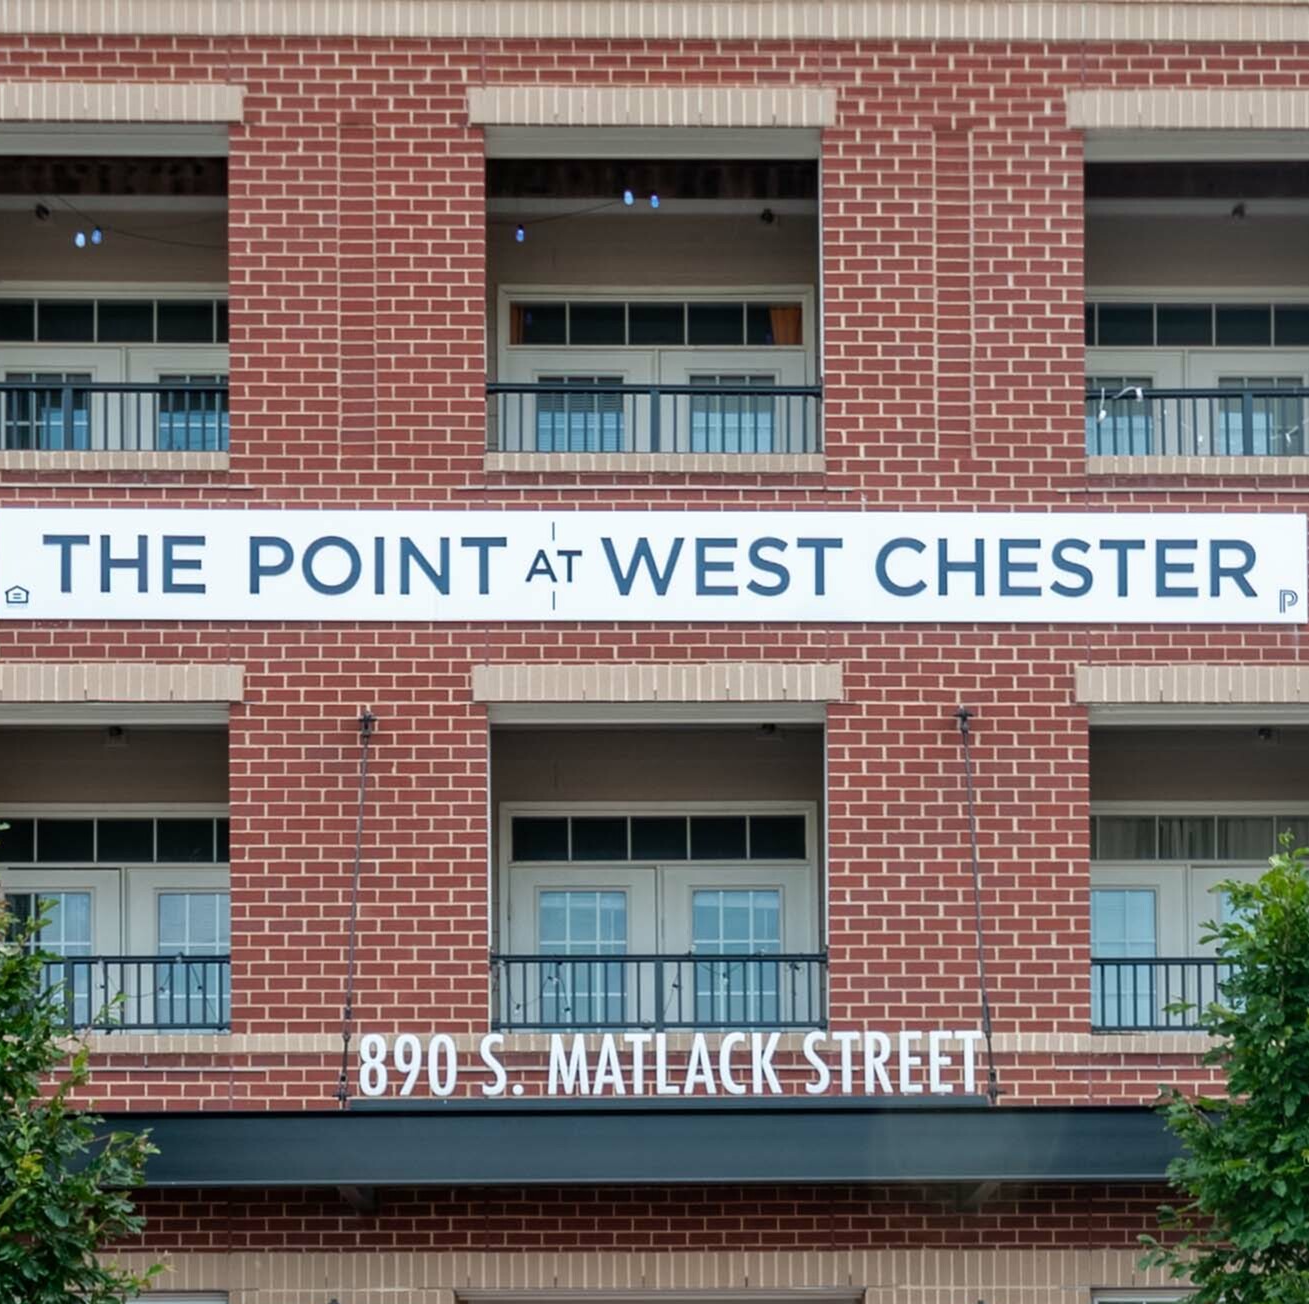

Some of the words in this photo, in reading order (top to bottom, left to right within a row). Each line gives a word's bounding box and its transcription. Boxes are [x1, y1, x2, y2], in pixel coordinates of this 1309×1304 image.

[43, 534, 207, 595] THE
[249, 535, 508, 597] POINT
[525, 549, 583, 583] AT
[600, 536, 844, 597] WEST
[875, 537, 1258, 598] CHESTER
[359, 1033, 457, 1096] 890
[477, 1033, 524, 1095] S.
[548, 1031, 783, 1095] MATLACK
[802, 1029, 986, 1094] STREET
